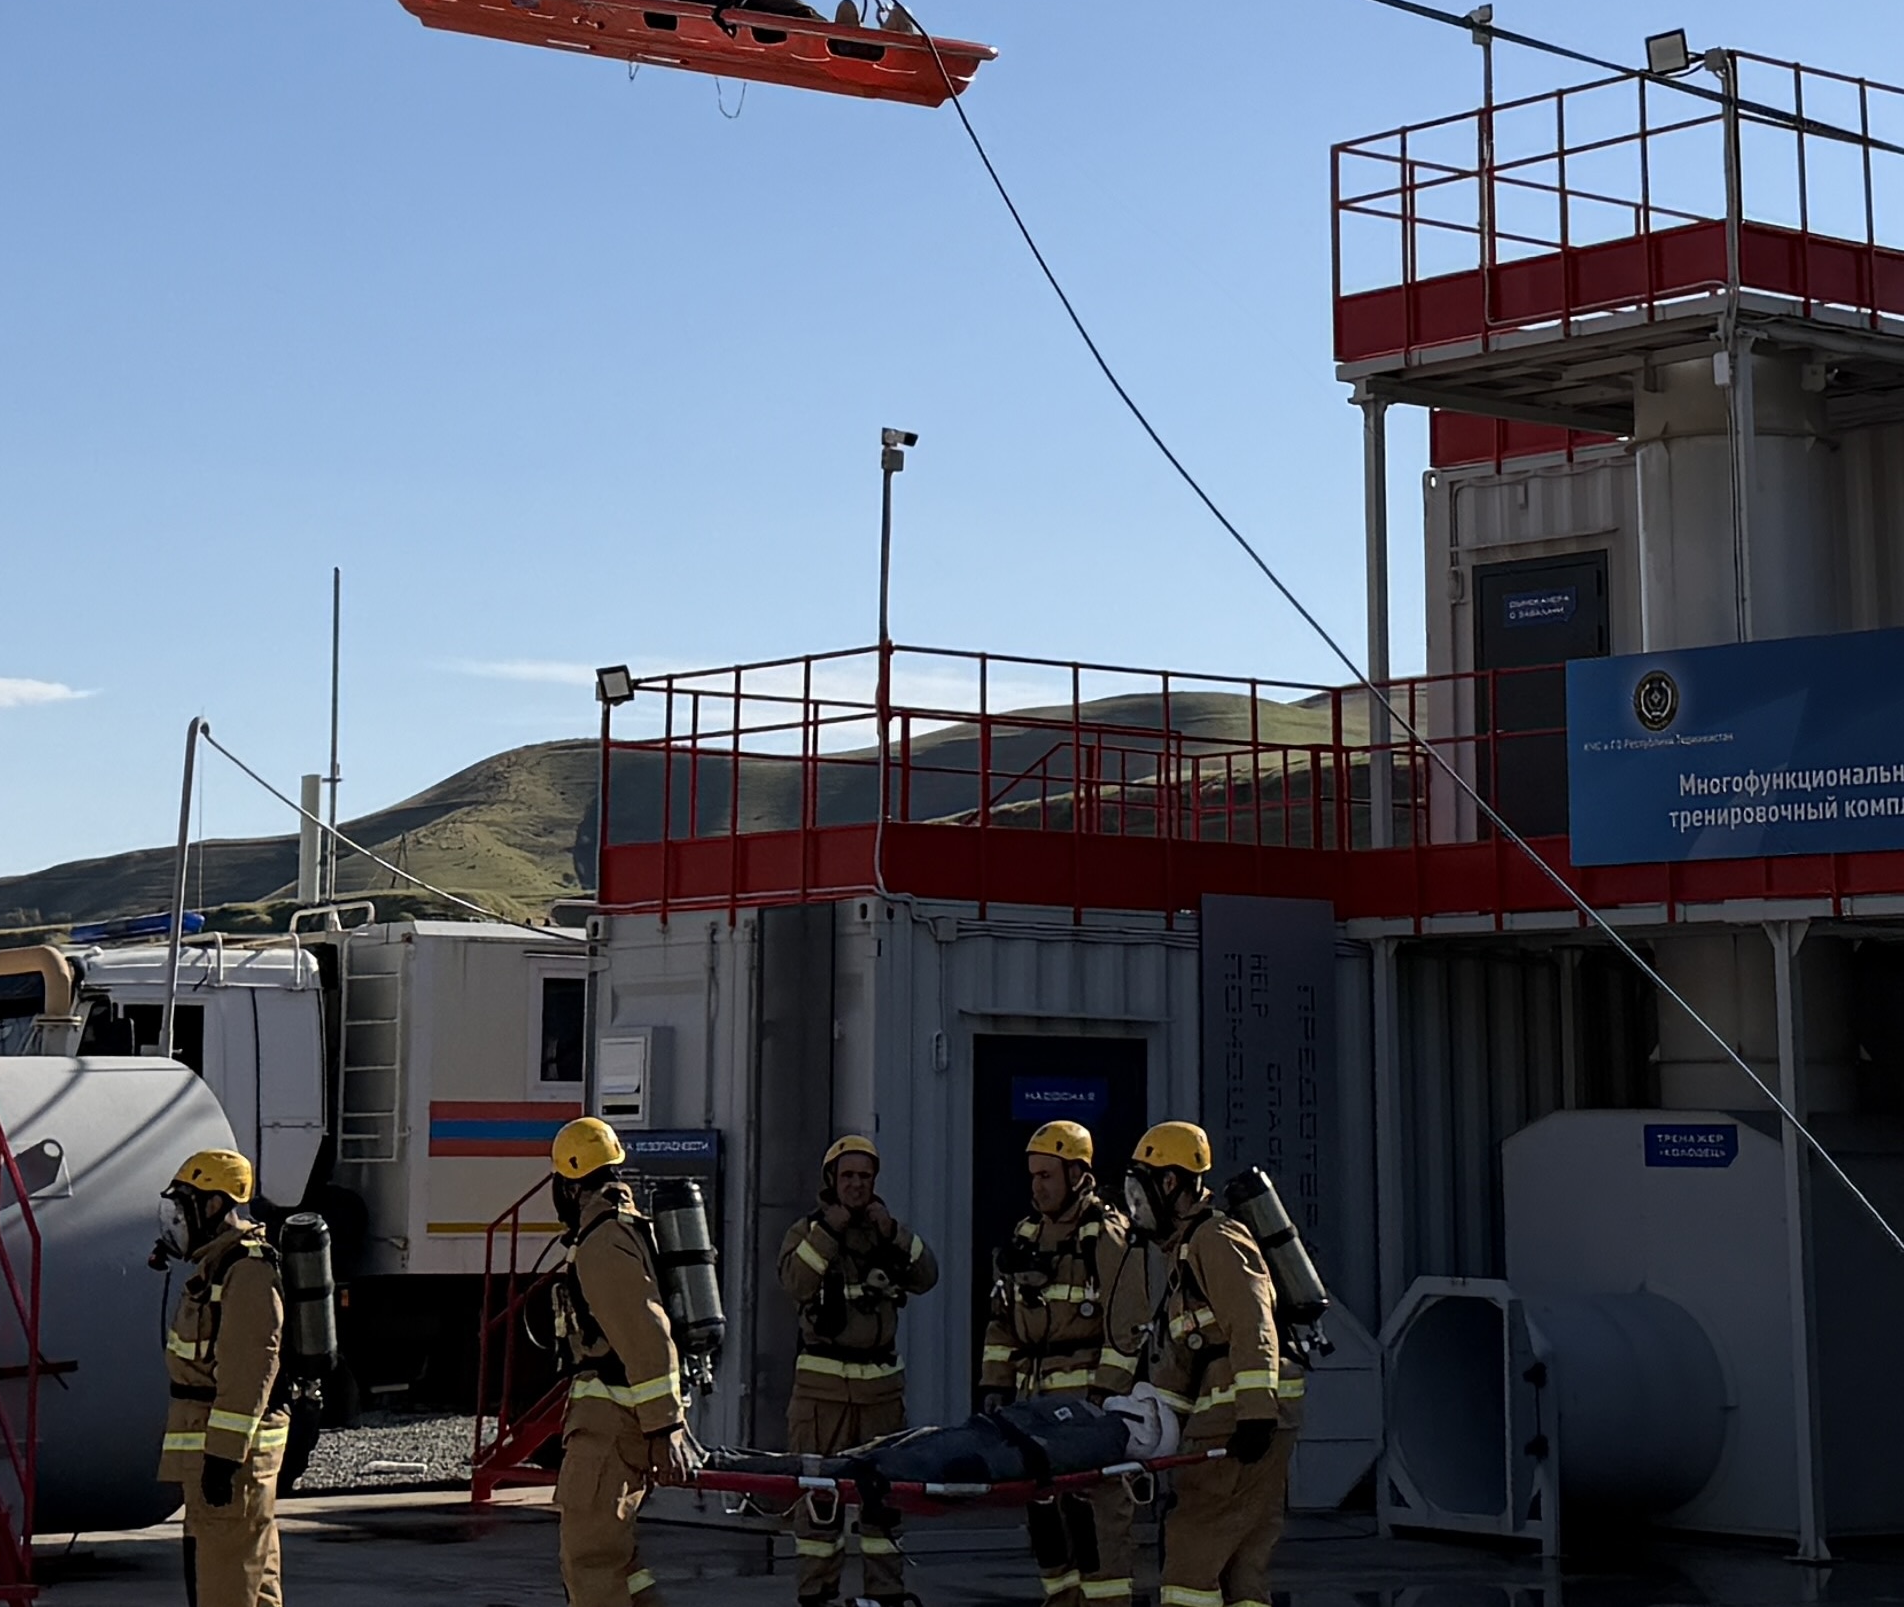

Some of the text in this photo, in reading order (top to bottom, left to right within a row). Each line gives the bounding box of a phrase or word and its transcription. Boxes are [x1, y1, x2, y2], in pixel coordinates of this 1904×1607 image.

[1669, 796, 1838, 833] тренировочный
[1250, 955, 1268, 1018] HELP
[1656, 1134, 1725, 1143] ТРЕНАЖЕР
